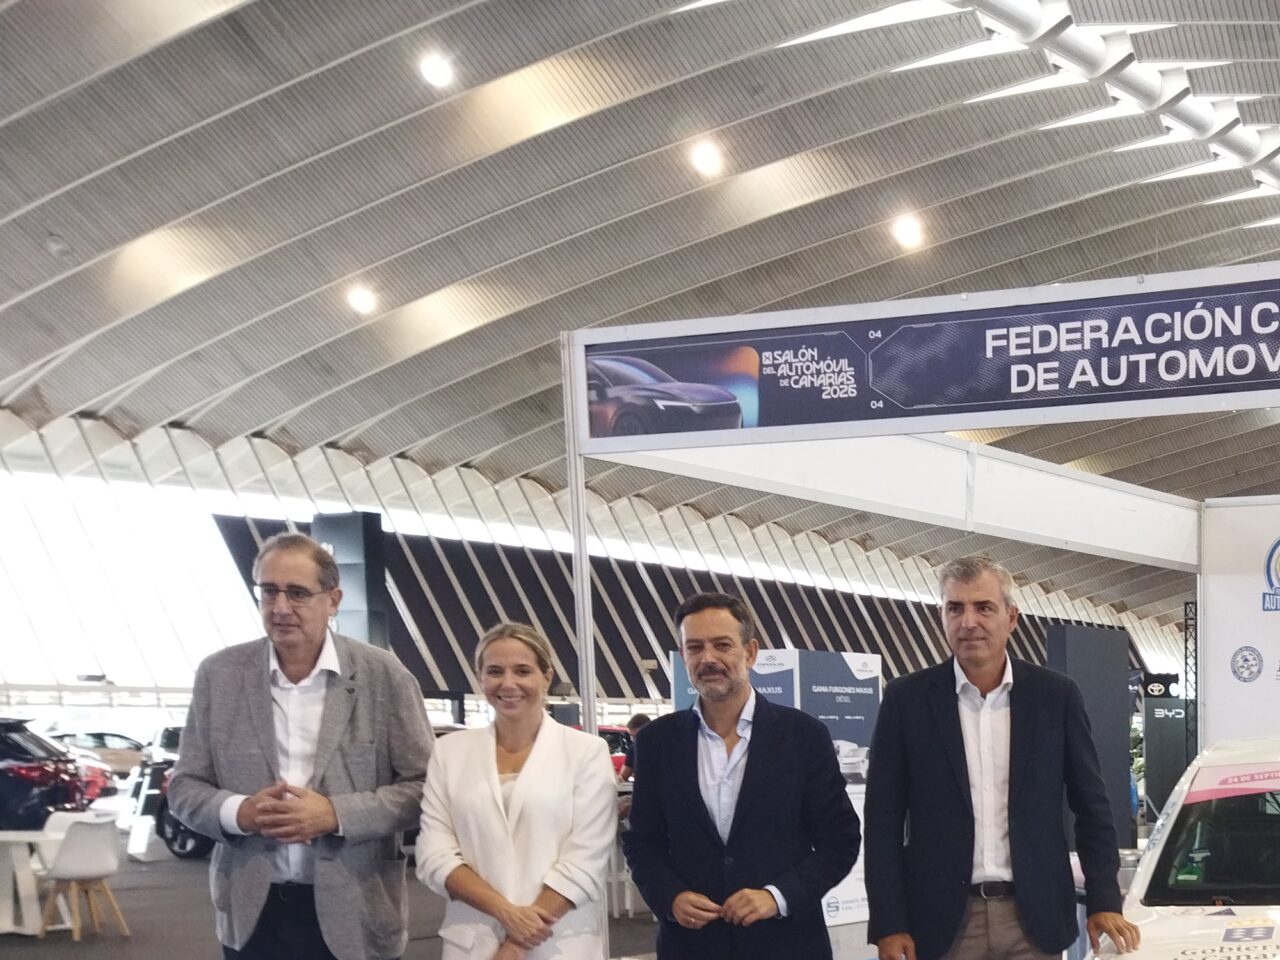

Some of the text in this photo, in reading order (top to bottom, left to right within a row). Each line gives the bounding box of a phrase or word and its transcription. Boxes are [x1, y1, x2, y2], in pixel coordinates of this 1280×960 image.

[868, 330, 882, 339] 04
[985, 302, 1242, 358] FEDERACIÓN
[774, 345, 818, 364] SALÓN
[763, 356, 854, 377] DEL AUTOMÓVIL
[780, 372, 856, 389] DE CANARIAS
[1009, 363, 1060, 394] DE
[822, 385, 858, 400] 2026
[870, 400, 884, 409] 04
[1154, 708, 1186, 718] BYD
